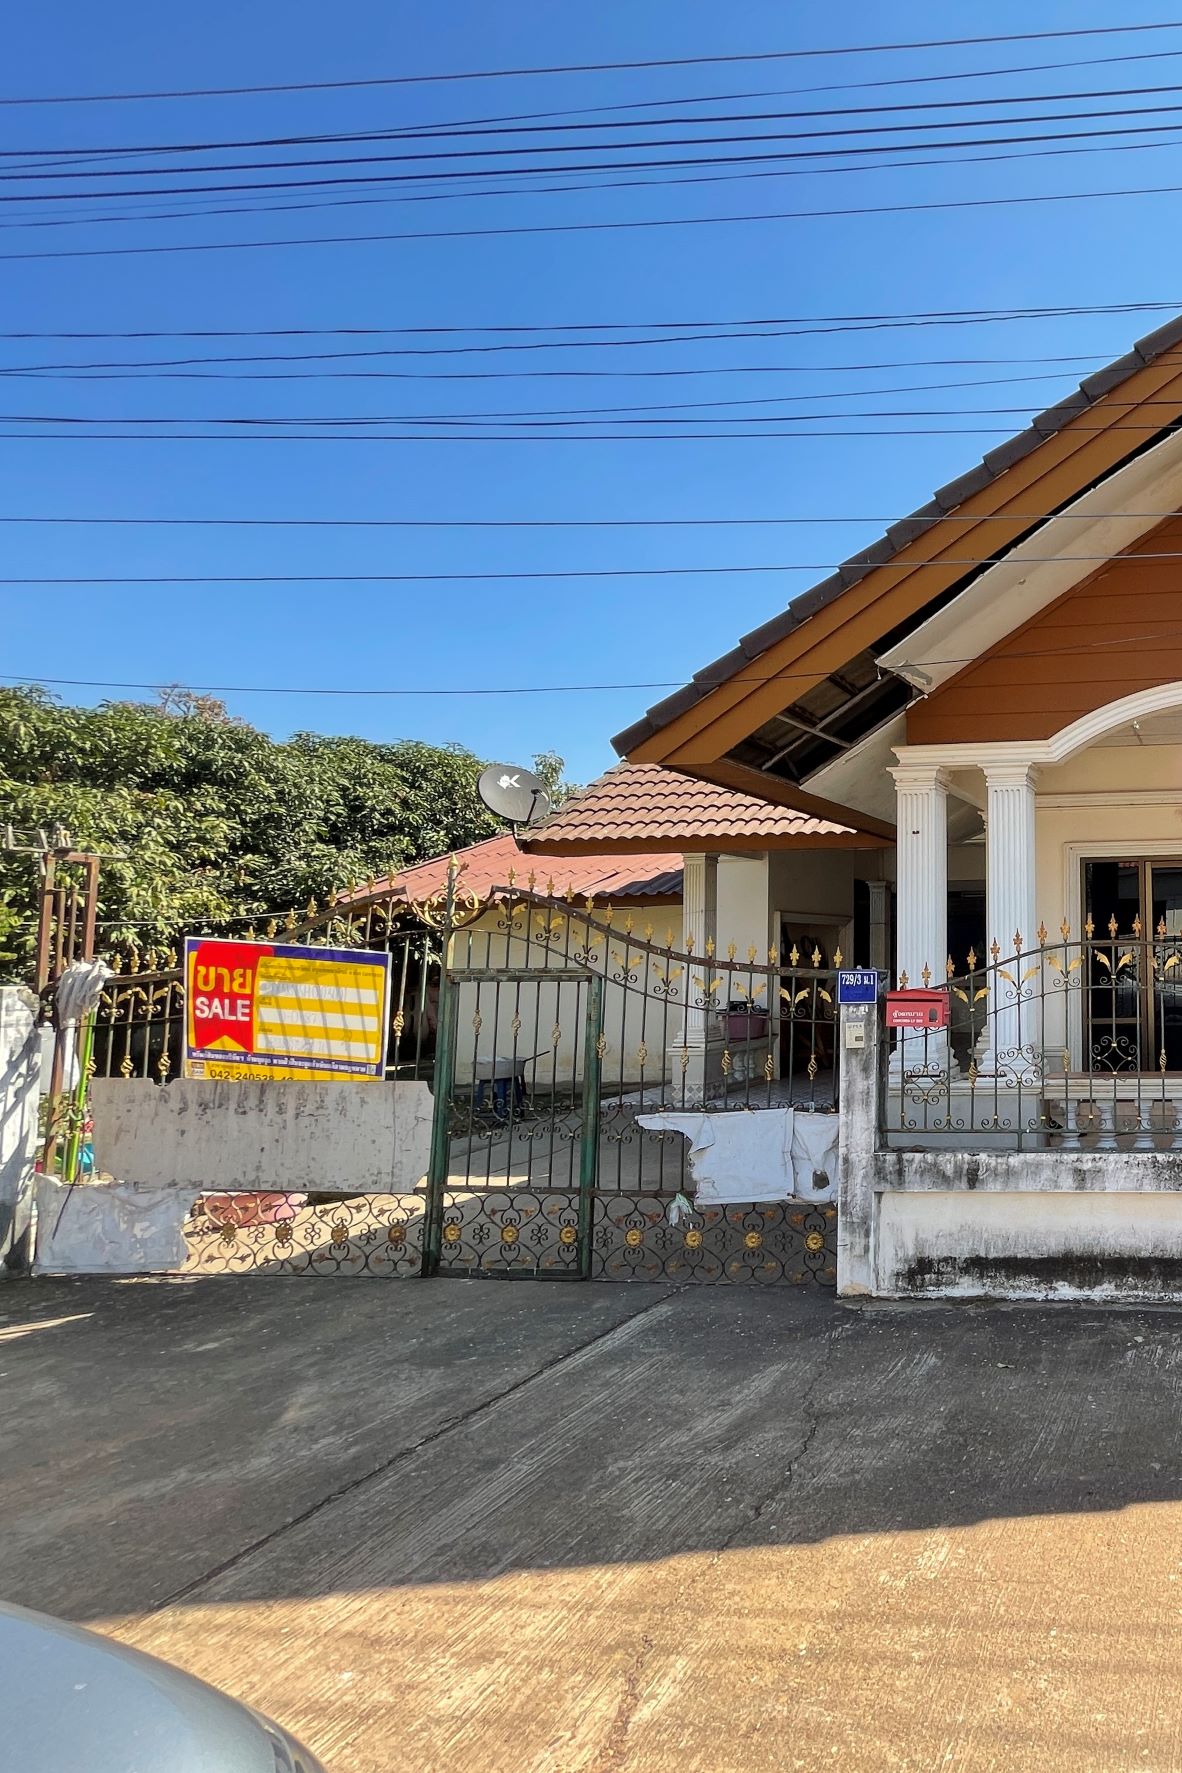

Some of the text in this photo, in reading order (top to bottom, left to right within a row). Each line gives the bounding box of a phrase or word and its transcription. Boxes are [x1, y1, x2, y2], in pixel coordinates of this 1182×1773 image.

[197, 966, 253, 994] ขาย
[842, 974, 861, 986] 729/3
[195, 996, 251, 1021] SALE
